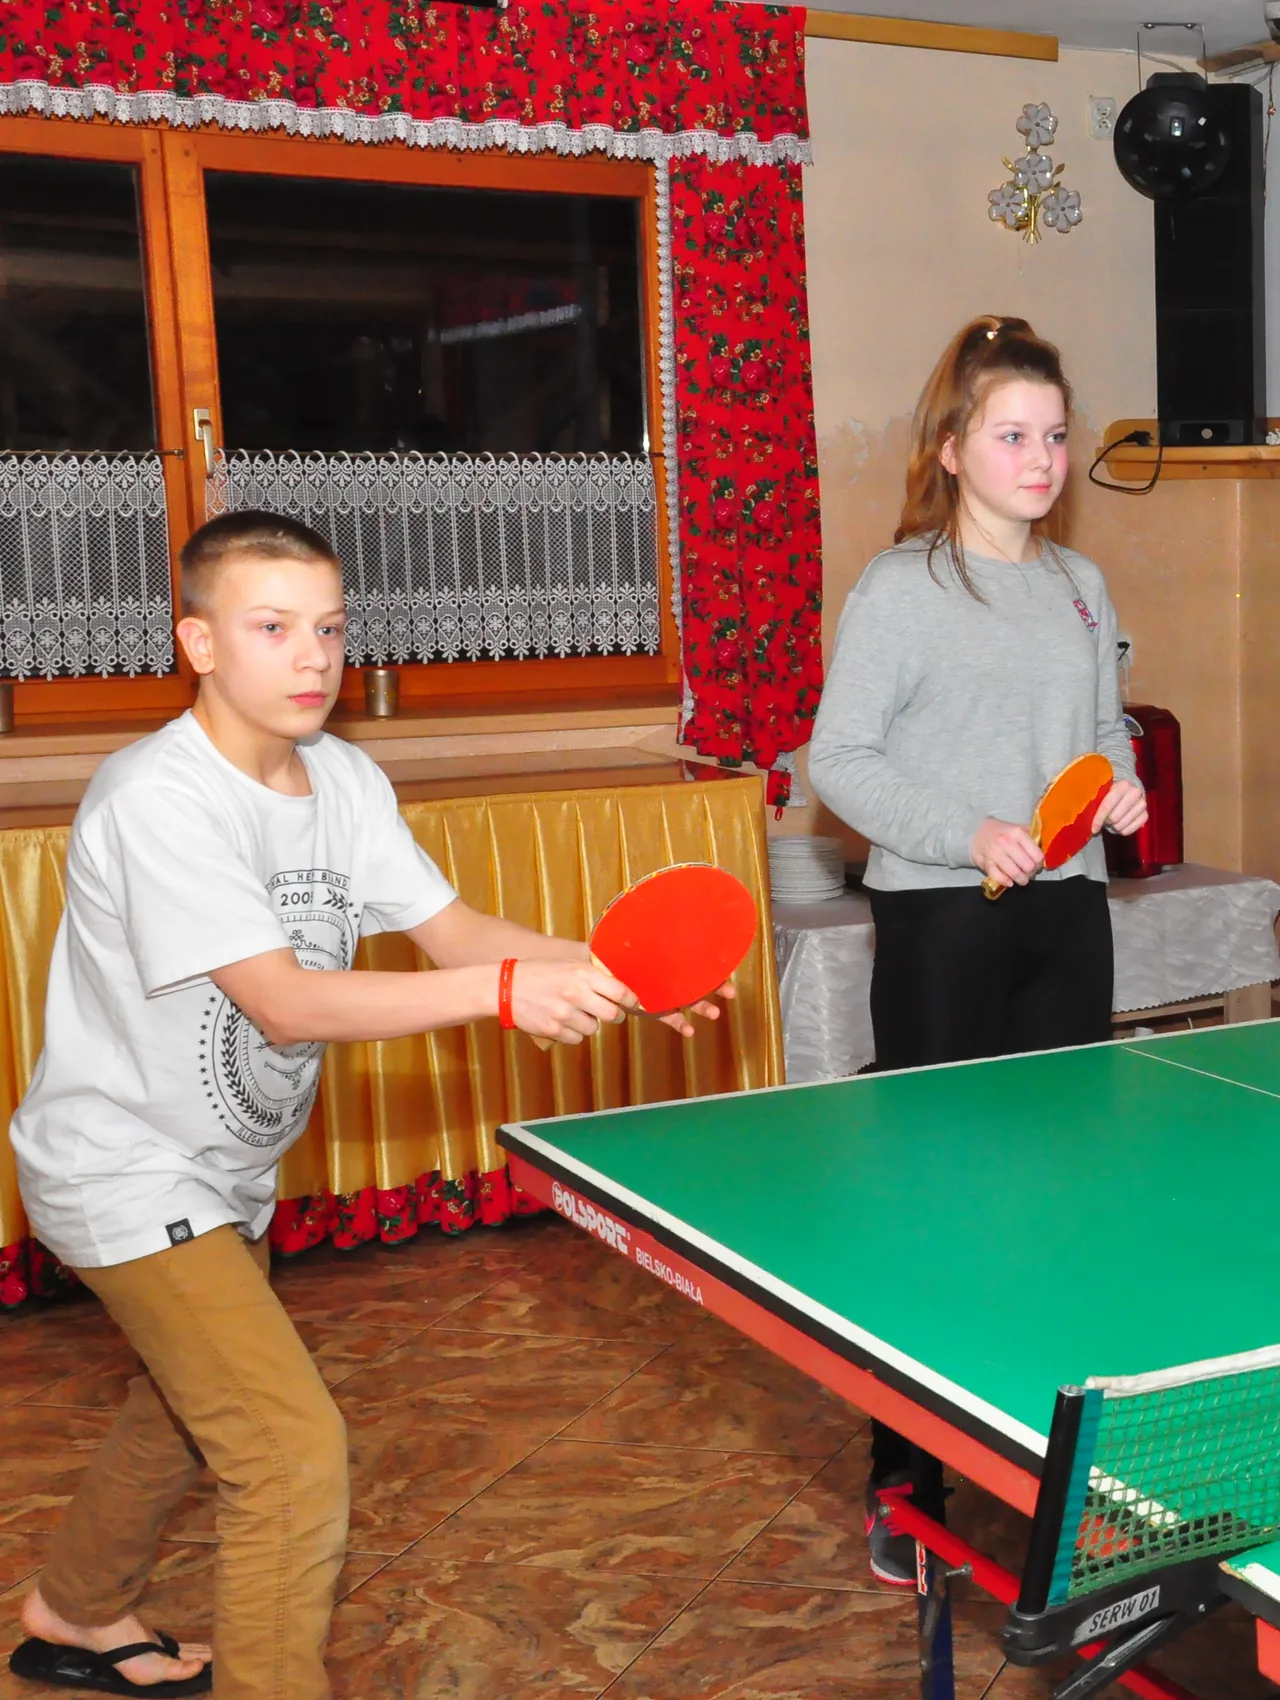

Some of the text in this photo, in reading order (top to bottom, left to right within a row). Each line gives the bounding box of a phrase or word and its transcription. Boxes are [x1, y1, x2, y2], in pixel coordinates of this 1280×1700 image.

[635, 1247, 704, 1306] BIELSKO-BIAŁA
[1089, 1589, 1158, 1633] SERW 01
